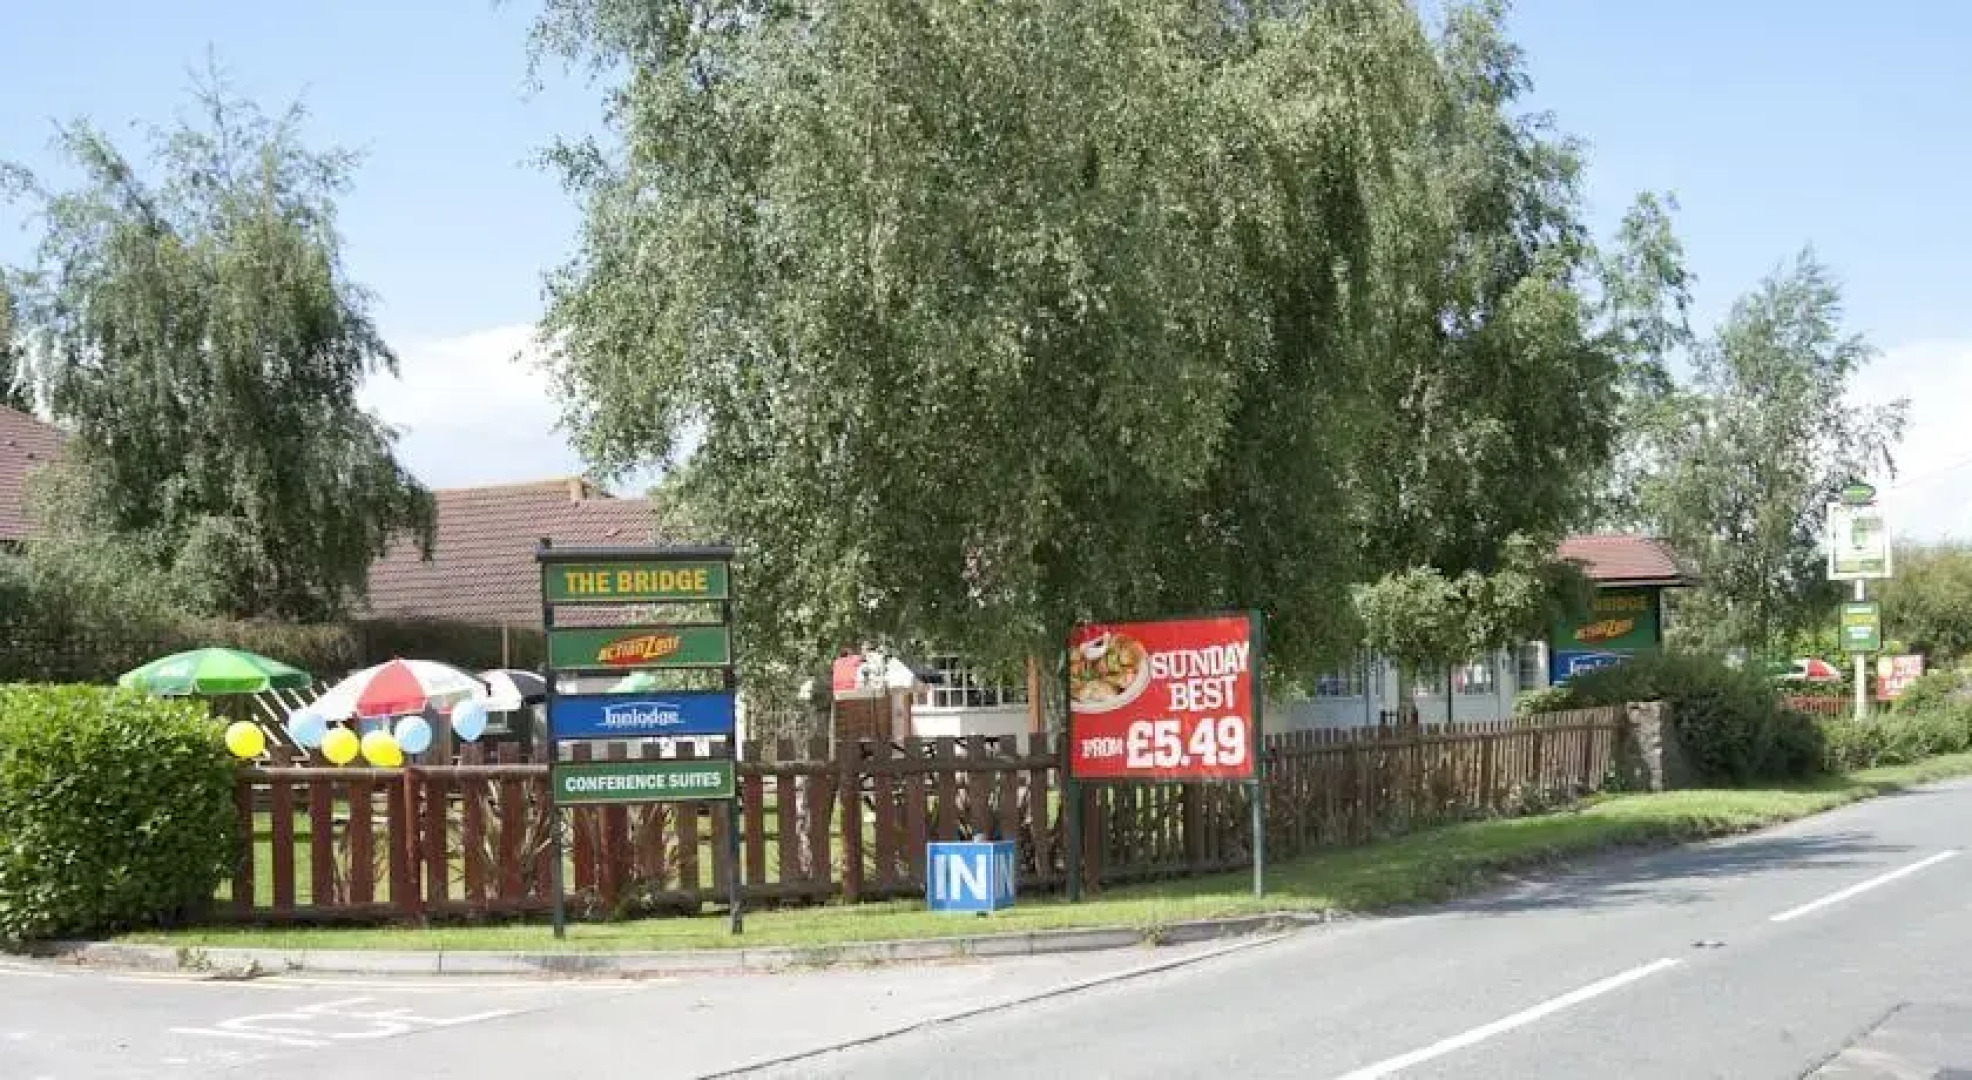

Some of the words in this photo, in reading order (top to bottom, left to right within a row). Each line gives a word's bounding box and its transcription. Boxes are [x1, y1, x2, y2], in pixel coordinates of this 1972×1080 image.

[565, 571, 611, 593] THE
[616, 569, 708, 593] BRIDGE
[1151, 640, 1250, 680] SUNDAY
[1166, 675, 1238, 712] BEST
[1081, 736, 1123, 758] FROM
[1126, 715, 1246, 769] £5.49
[564, 774, 667, 792] CONFERENCE
[669, 771, 722, 788] SUITES
[933, 853, 987, 900] IN
